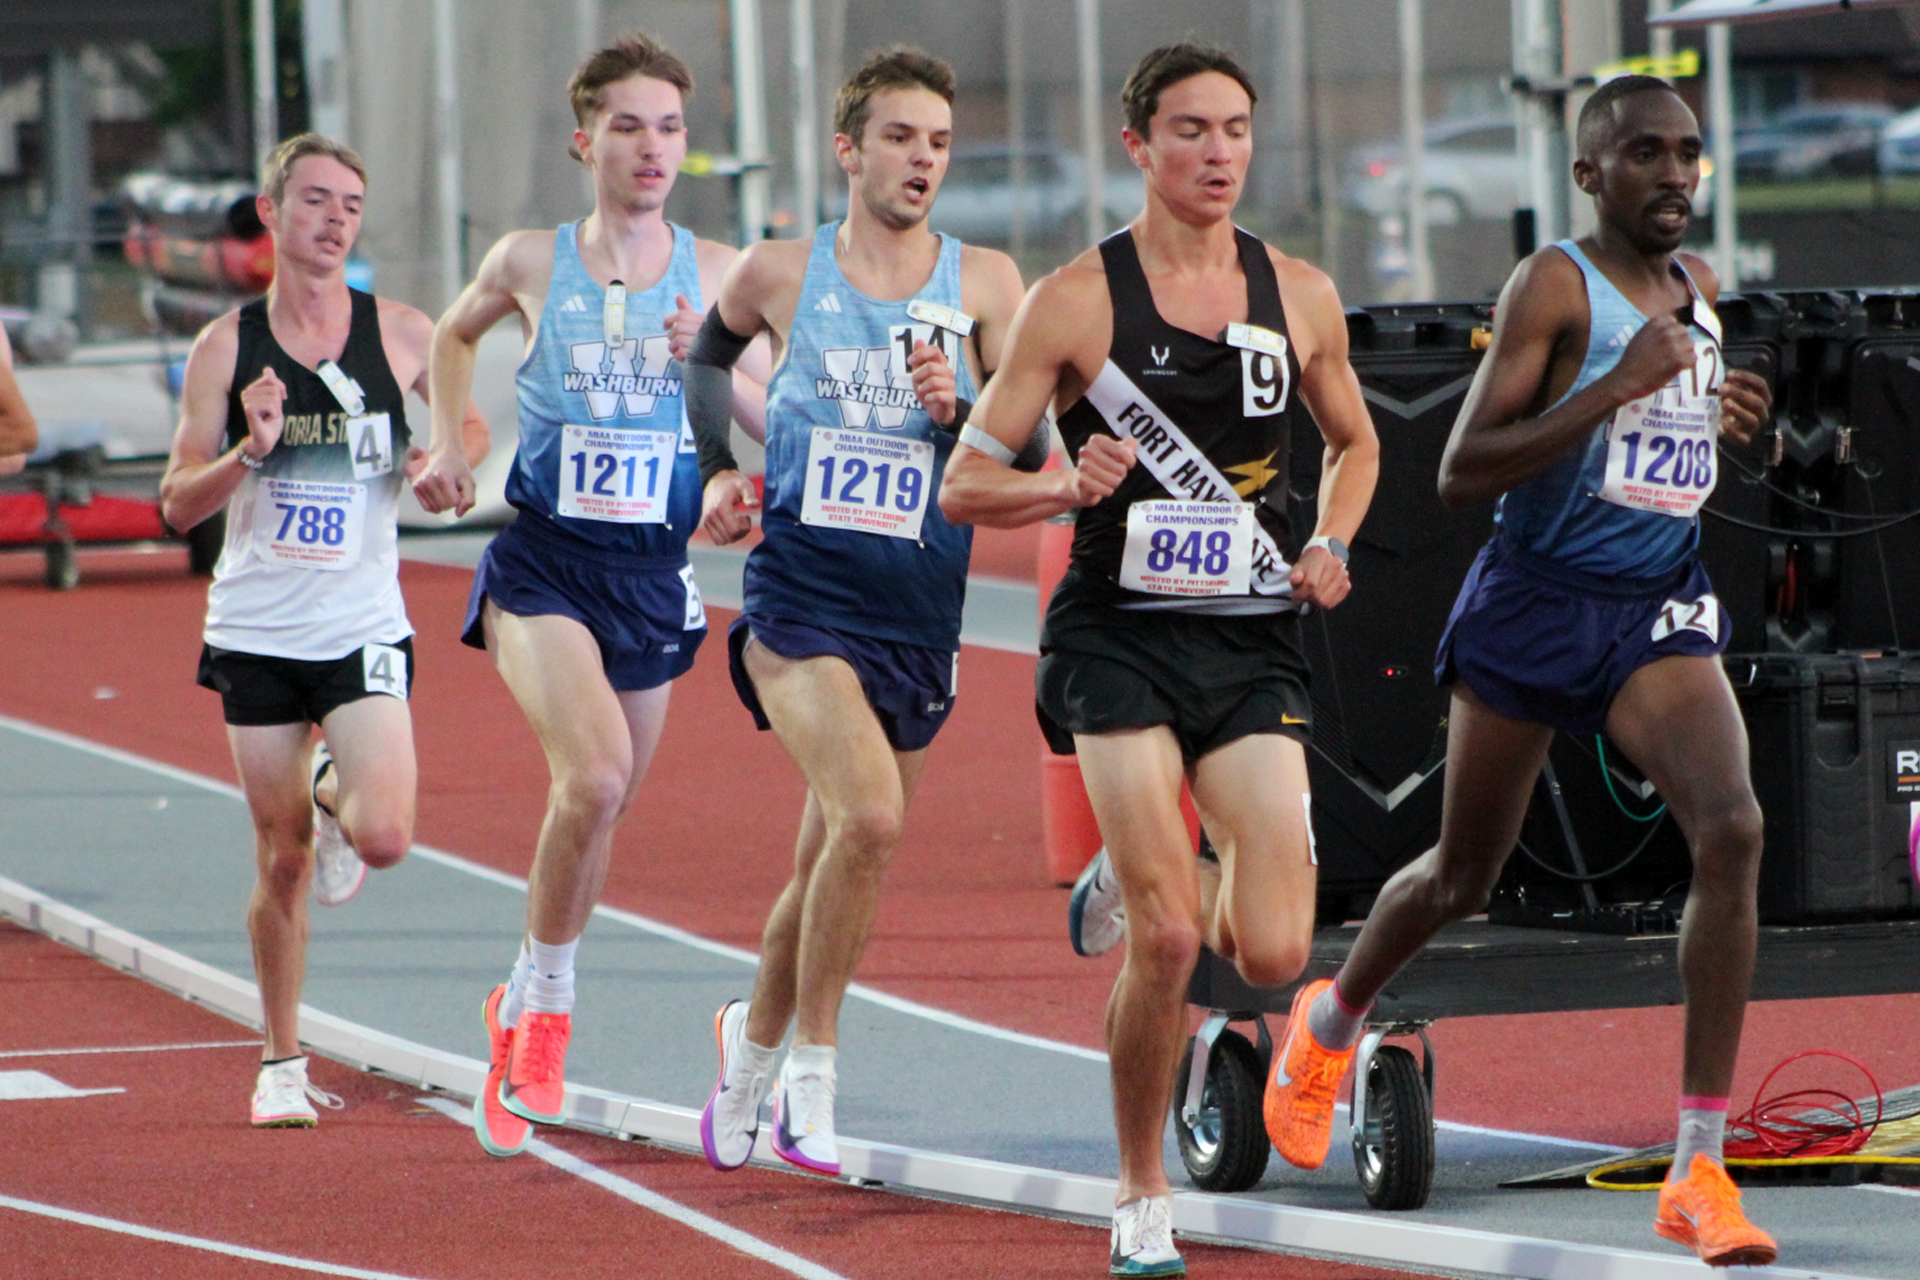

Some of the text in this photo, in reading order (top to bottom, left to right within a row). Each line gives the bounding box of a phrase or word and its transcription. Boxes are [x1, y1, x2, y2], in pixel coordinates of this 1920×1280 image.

[563, 372, 682, 397] WASHBURN
[815, 378, 924, 411] WASHBUR
[1251, 350, 1284, 411] 9
[283, 414, 322, 446] ORIA
[588, 430, 652, 442] MIAA OUTDOOR
[839, 433, 909, 451] MIAA OUTDOOR
[355, 424, 382, 472] 4
[584, 439, 655, 451] CHAMPIONSHIPS
[834, 443, 911, 461] CHAMPIONSHIPS
[1116, 401, 1231, 503] FORT HAY
[570, 451, 660, 498] 1211
[1621, 431, 1711, 490] 1208
[271, 491, 352, 504] CHAMPIONSHIPS
[818, 456, 923, 513] 1219
[821, 504, 908, 523] HOSTED BY PITTSBURG
[828, 513, 852, 524] STATE
[854, 515, 898, 530] UNIVERSITY
[1145, 514, 1239, 526] CHAMPIONSHIPS
[1154, 503, 1232, 514] MIAA OUTDOOR
[275, 503, 346, 546] 788
[1147, 528, 1231, 576] 848
[1140, 575, 1172, 585] HOSTED
[1187, 578, 1230, 587] PITTSBURG
[1146, 583, 1222, 595] STATE UNIVERSITY
[1660, 601, 1709, 635] 12
[368, 651, 396, 690] 4
